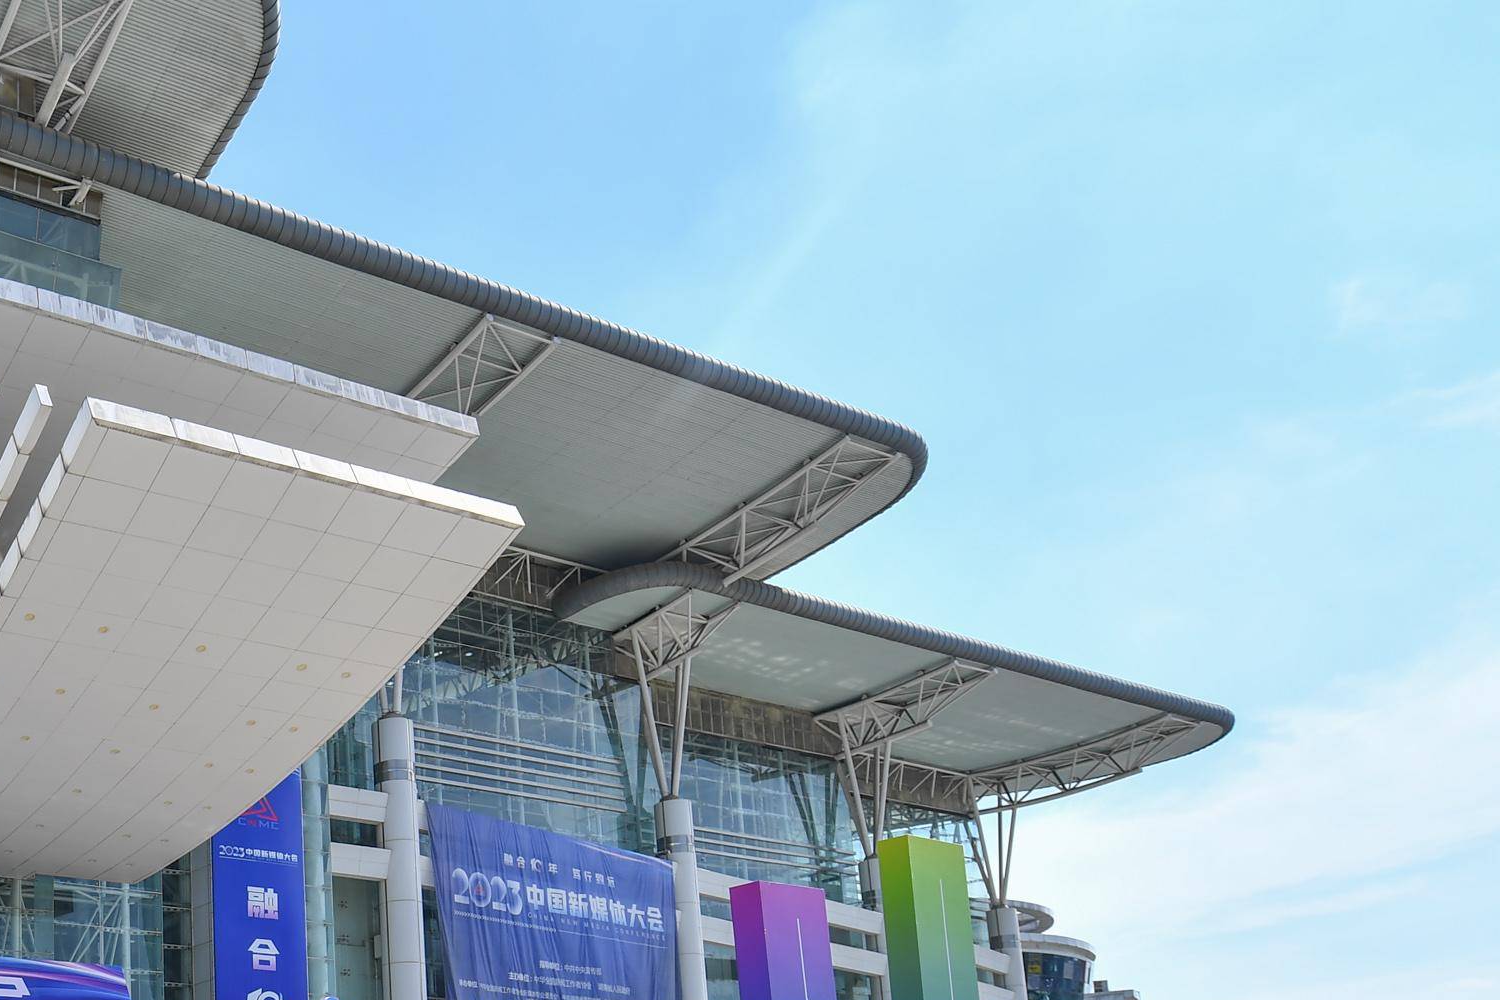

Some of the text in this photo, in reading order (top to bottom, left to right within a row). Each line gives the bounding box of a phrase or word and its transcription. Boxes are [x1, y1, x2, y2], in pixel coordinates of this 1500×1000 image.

[451, 867, 664, 932] 2023 中国新媒体大会
